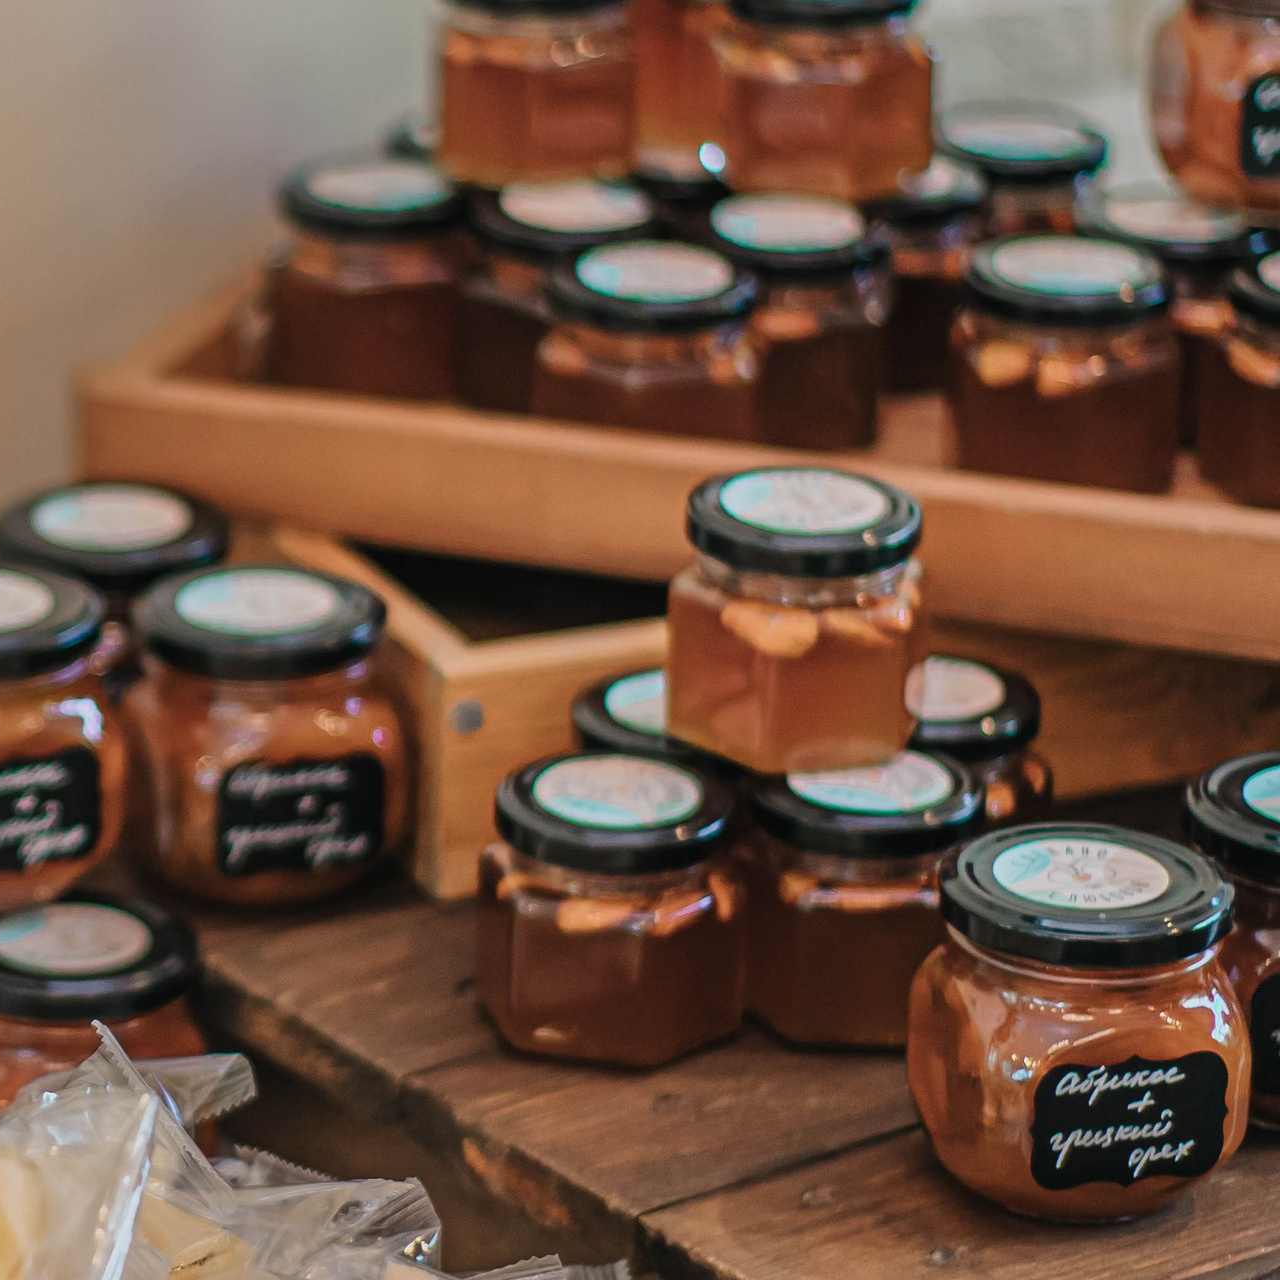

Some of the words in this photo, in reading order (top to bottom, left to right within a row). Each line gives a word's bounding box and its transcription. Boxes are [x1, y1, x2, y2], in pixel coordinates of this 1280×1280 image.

[1127, 1090, 1155, 1112] +
[1050, 1108, 1174, 1169] грецкий
[1128, 1139, 1195, 1179] орех
